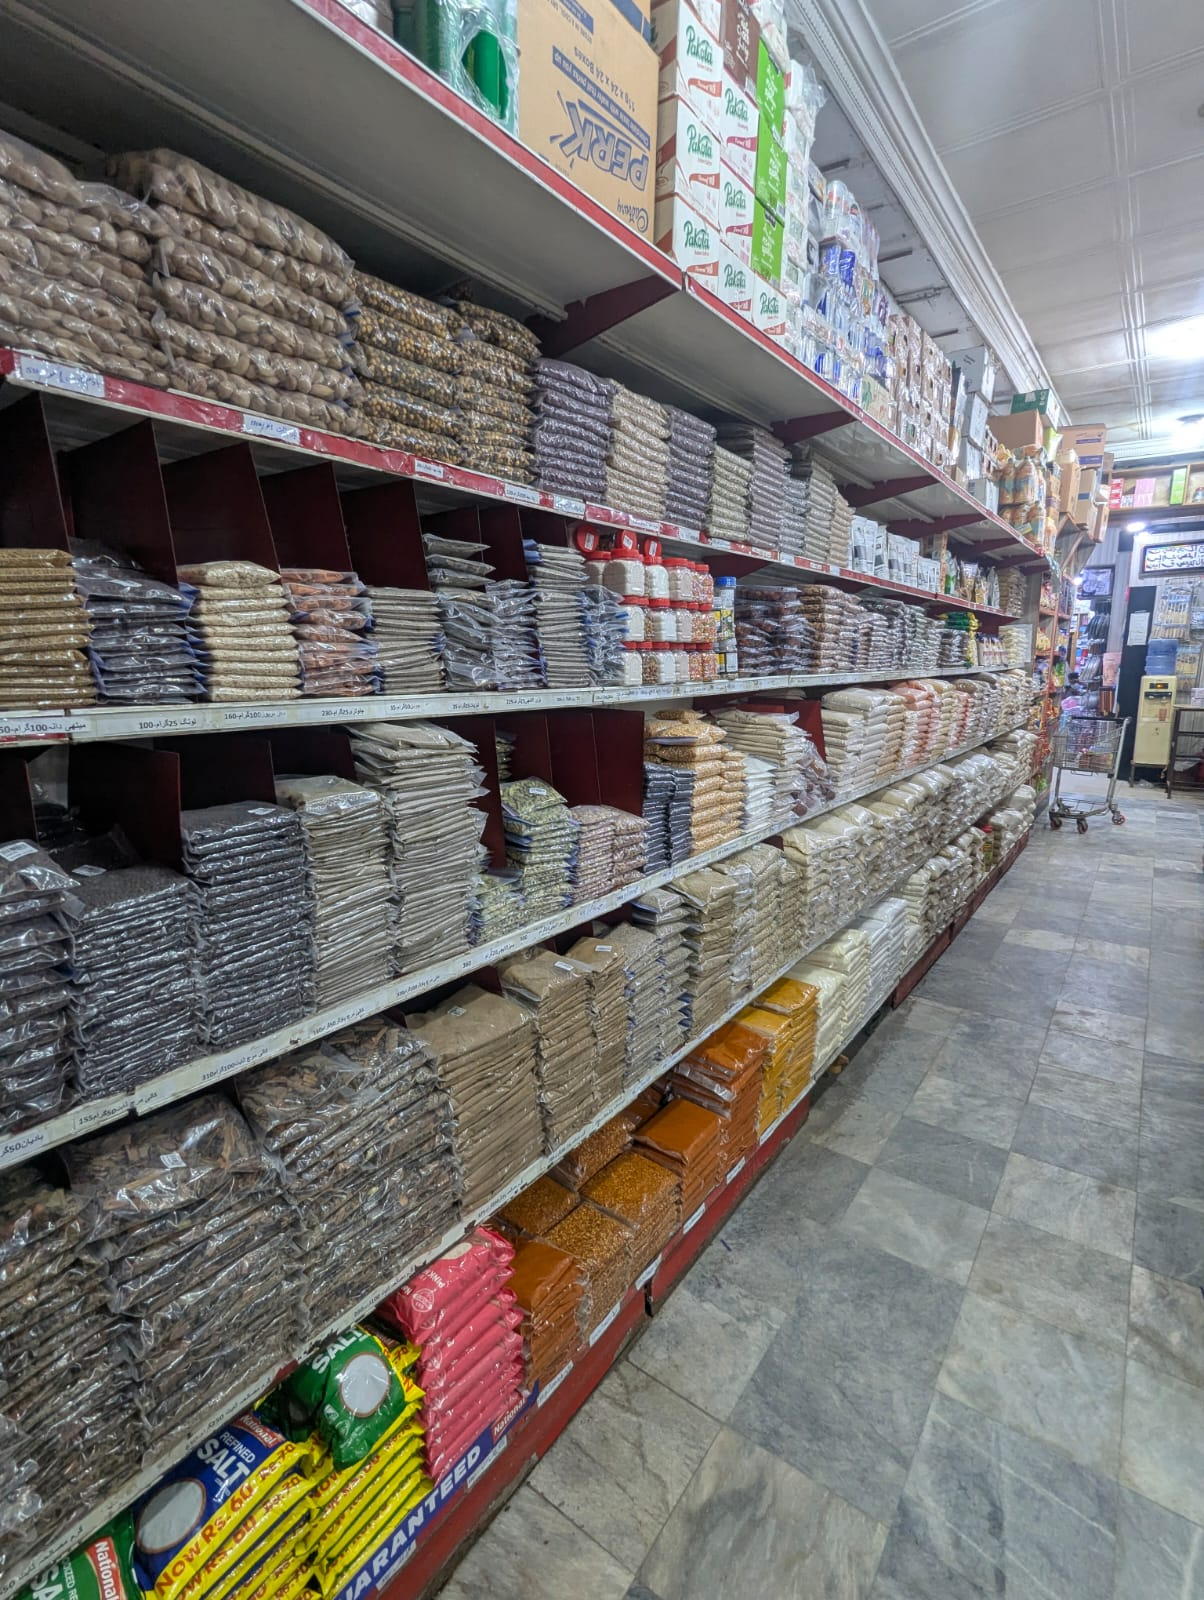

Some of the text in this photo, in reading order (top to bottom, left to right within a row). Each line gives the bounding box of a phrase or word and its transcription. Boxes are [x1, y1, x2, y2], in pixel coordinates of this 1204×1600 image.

[574, 46, 594, 74] Boxes
[558, 100, 650, 192] PERK
[240, 1414, 279, 1445] National
[493, 1397, 527, 1437] National
[197, 1438, 250, 1487] SALT
[219, 1431, 256, 1464] REFINED
[95, 1540, 120, 1600] National
[155, 1541, 201, 1597] NOW
